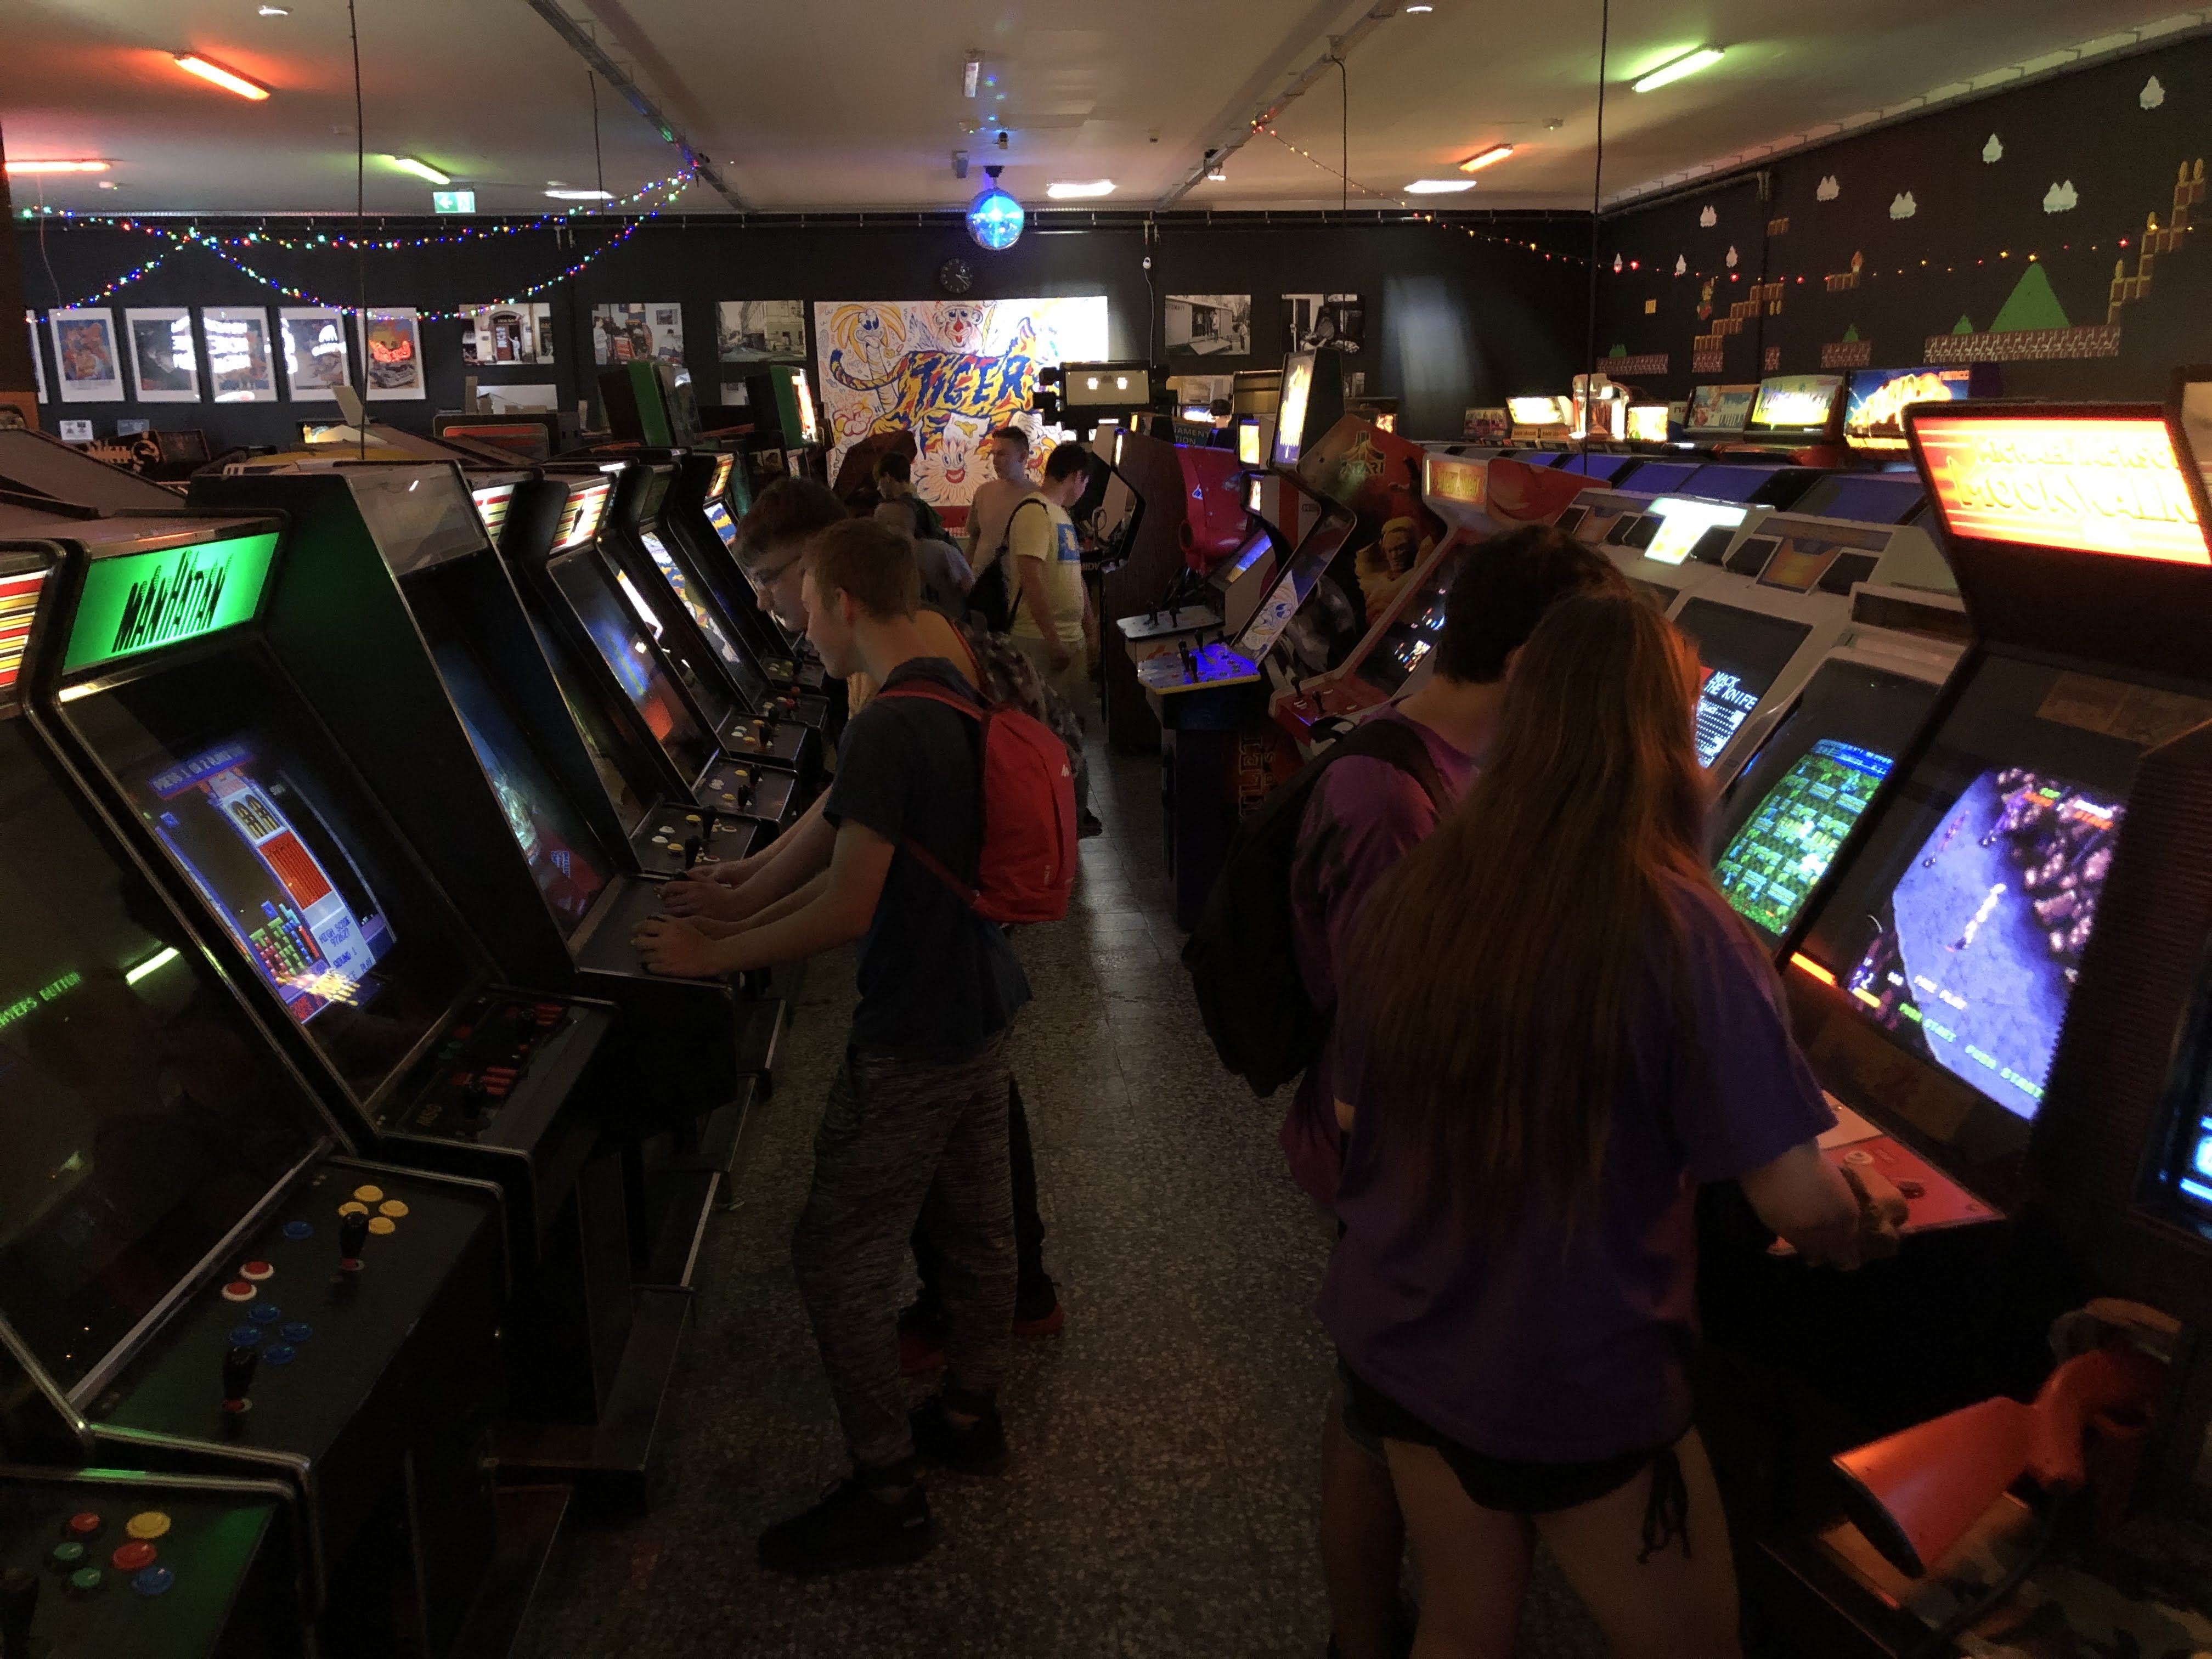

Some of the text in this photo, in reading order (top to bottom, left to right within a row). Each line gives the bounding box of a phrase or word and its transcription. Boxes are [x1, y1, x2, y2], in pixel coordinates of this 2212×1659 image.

[909, 354, 1025, 417] TIGER
[1712, 671, 1741, 689] MACK
[1703, 680, 1724, 695] THE
[1721, 687, 1759, 710] KNIFE
[318, 928, 336, 944] HIGH
